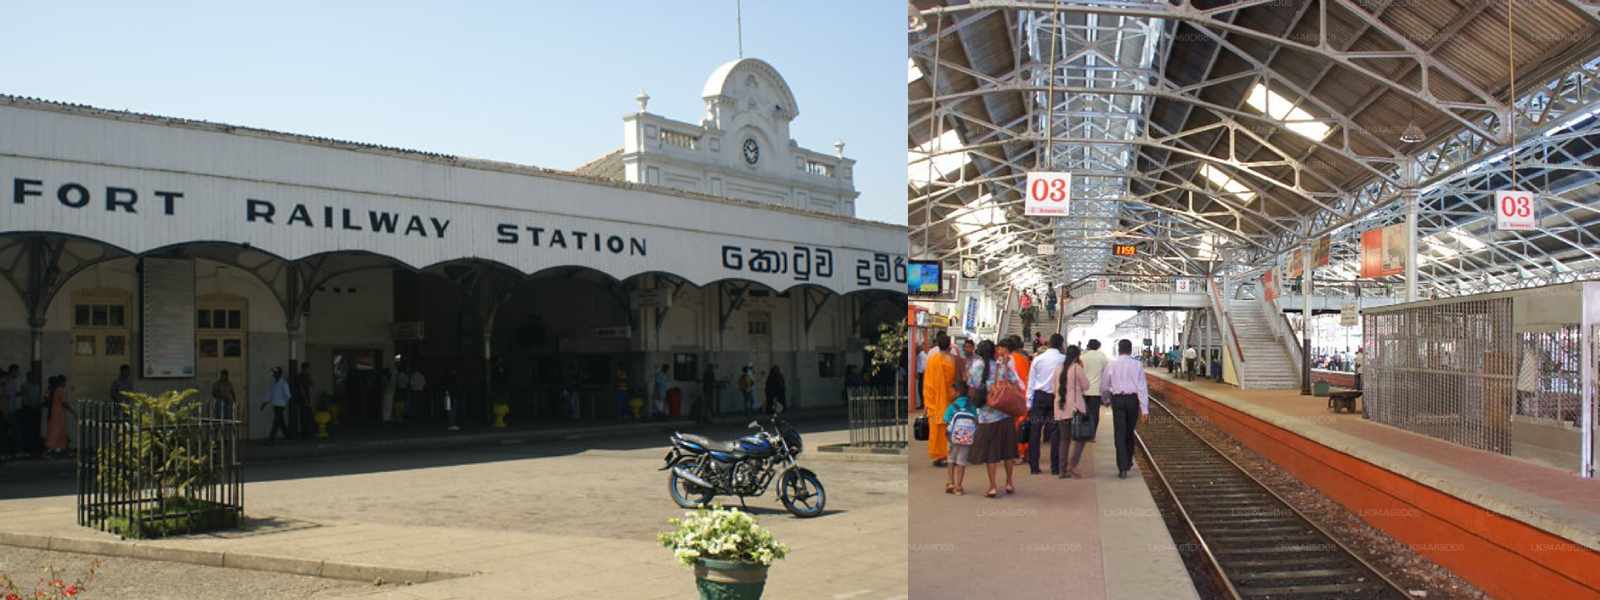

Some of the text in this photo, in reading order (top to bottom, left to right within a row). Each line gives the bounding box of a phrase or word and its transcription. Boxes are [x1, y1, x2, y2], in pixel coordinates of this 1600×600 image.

[1031, 178, 1067, 202] 03
[13, 178, 648, 257] FORT RAILWAY STATION
[1502, 196, 1531, 217] 03
[721, 245, 834, 282] කොටුව
